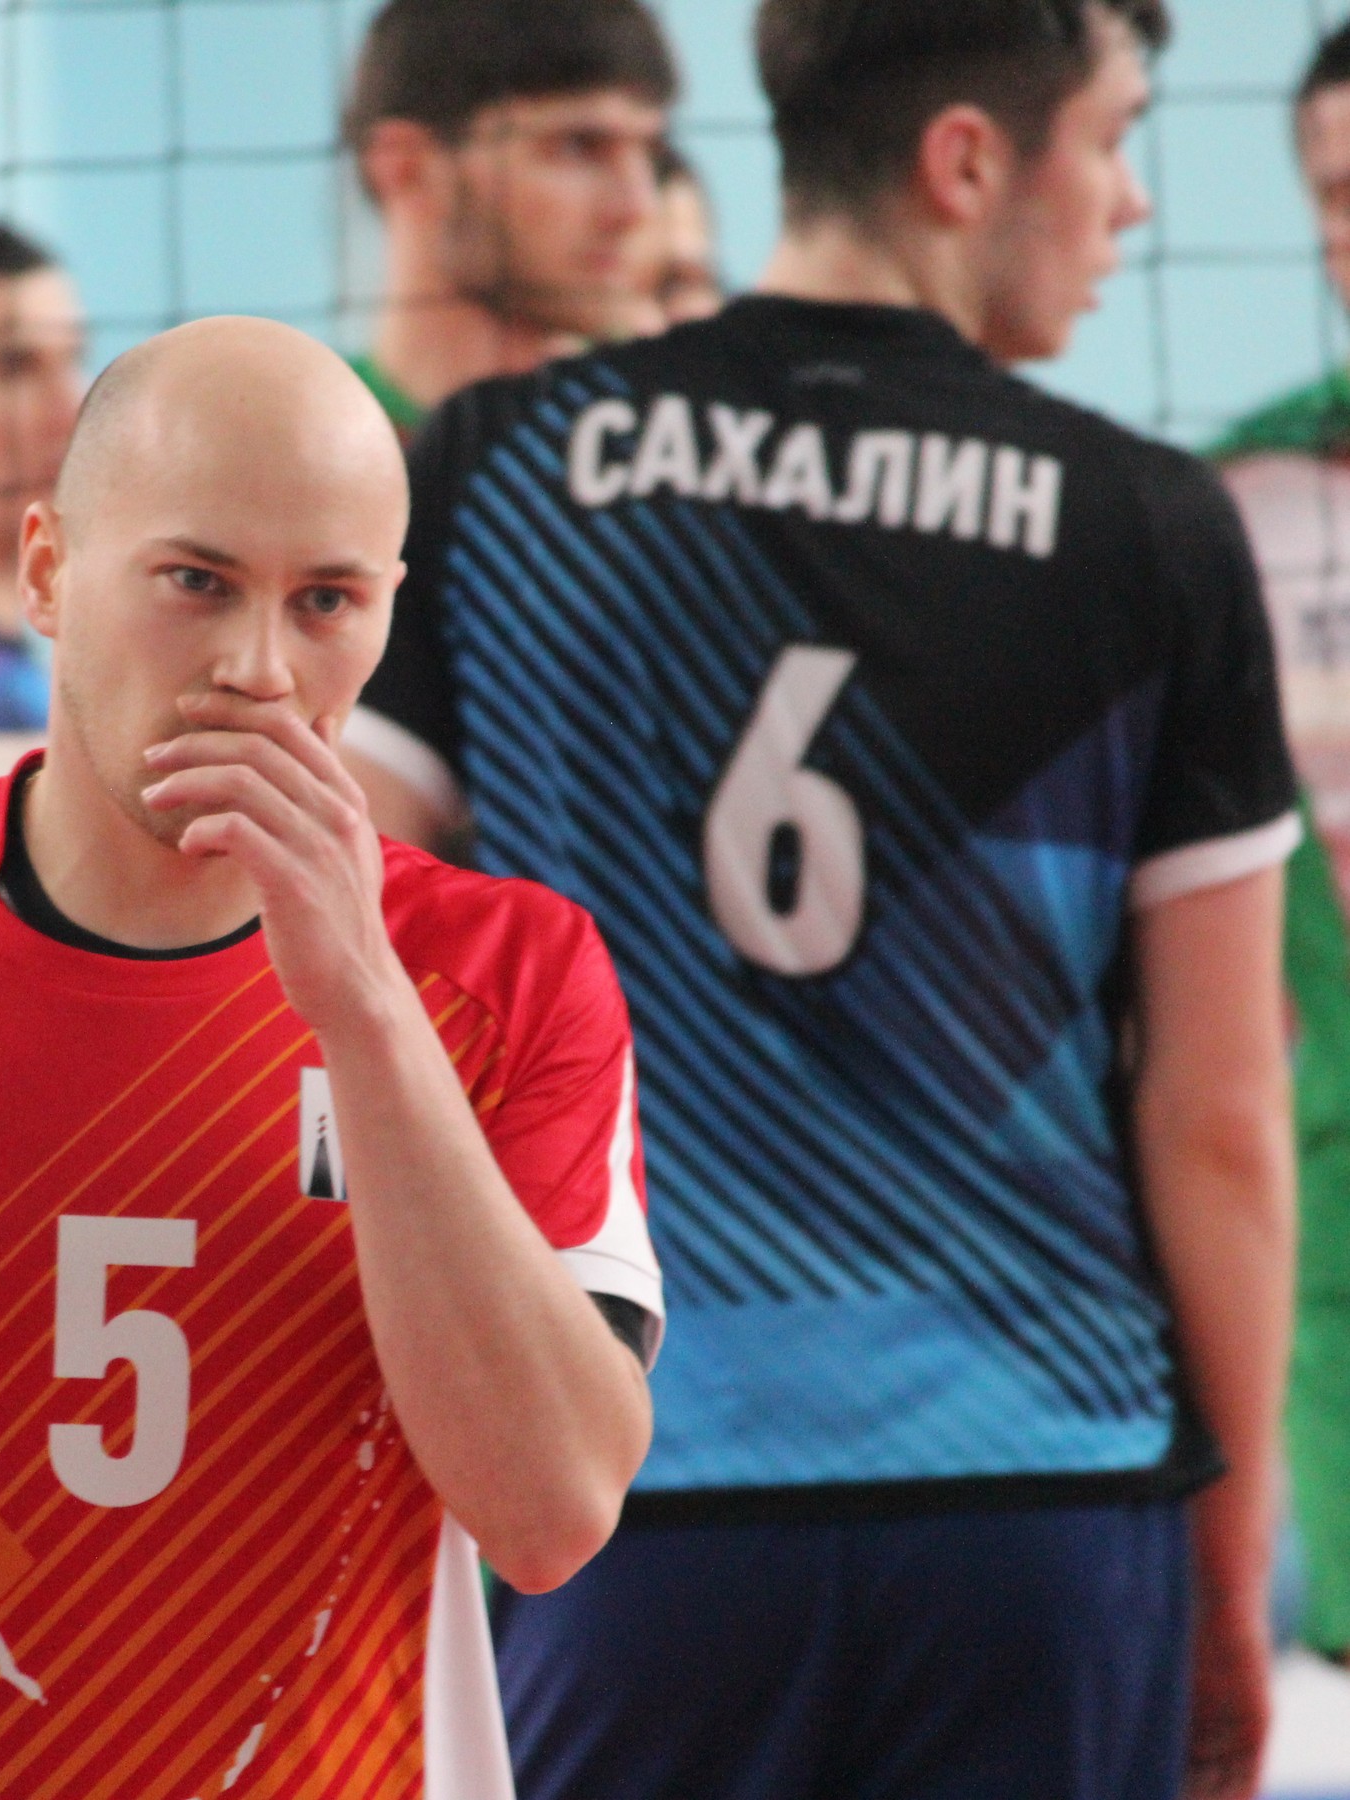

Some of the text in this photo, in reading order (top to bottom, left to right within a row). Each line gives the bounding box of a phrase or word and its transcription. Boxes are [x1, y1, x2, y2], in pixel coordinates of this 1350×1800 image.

[567, 395, 1061, 559] САХАЛИН
[705, 646, 864, 975] 6
[49, 1215, 197, 1507] 5
